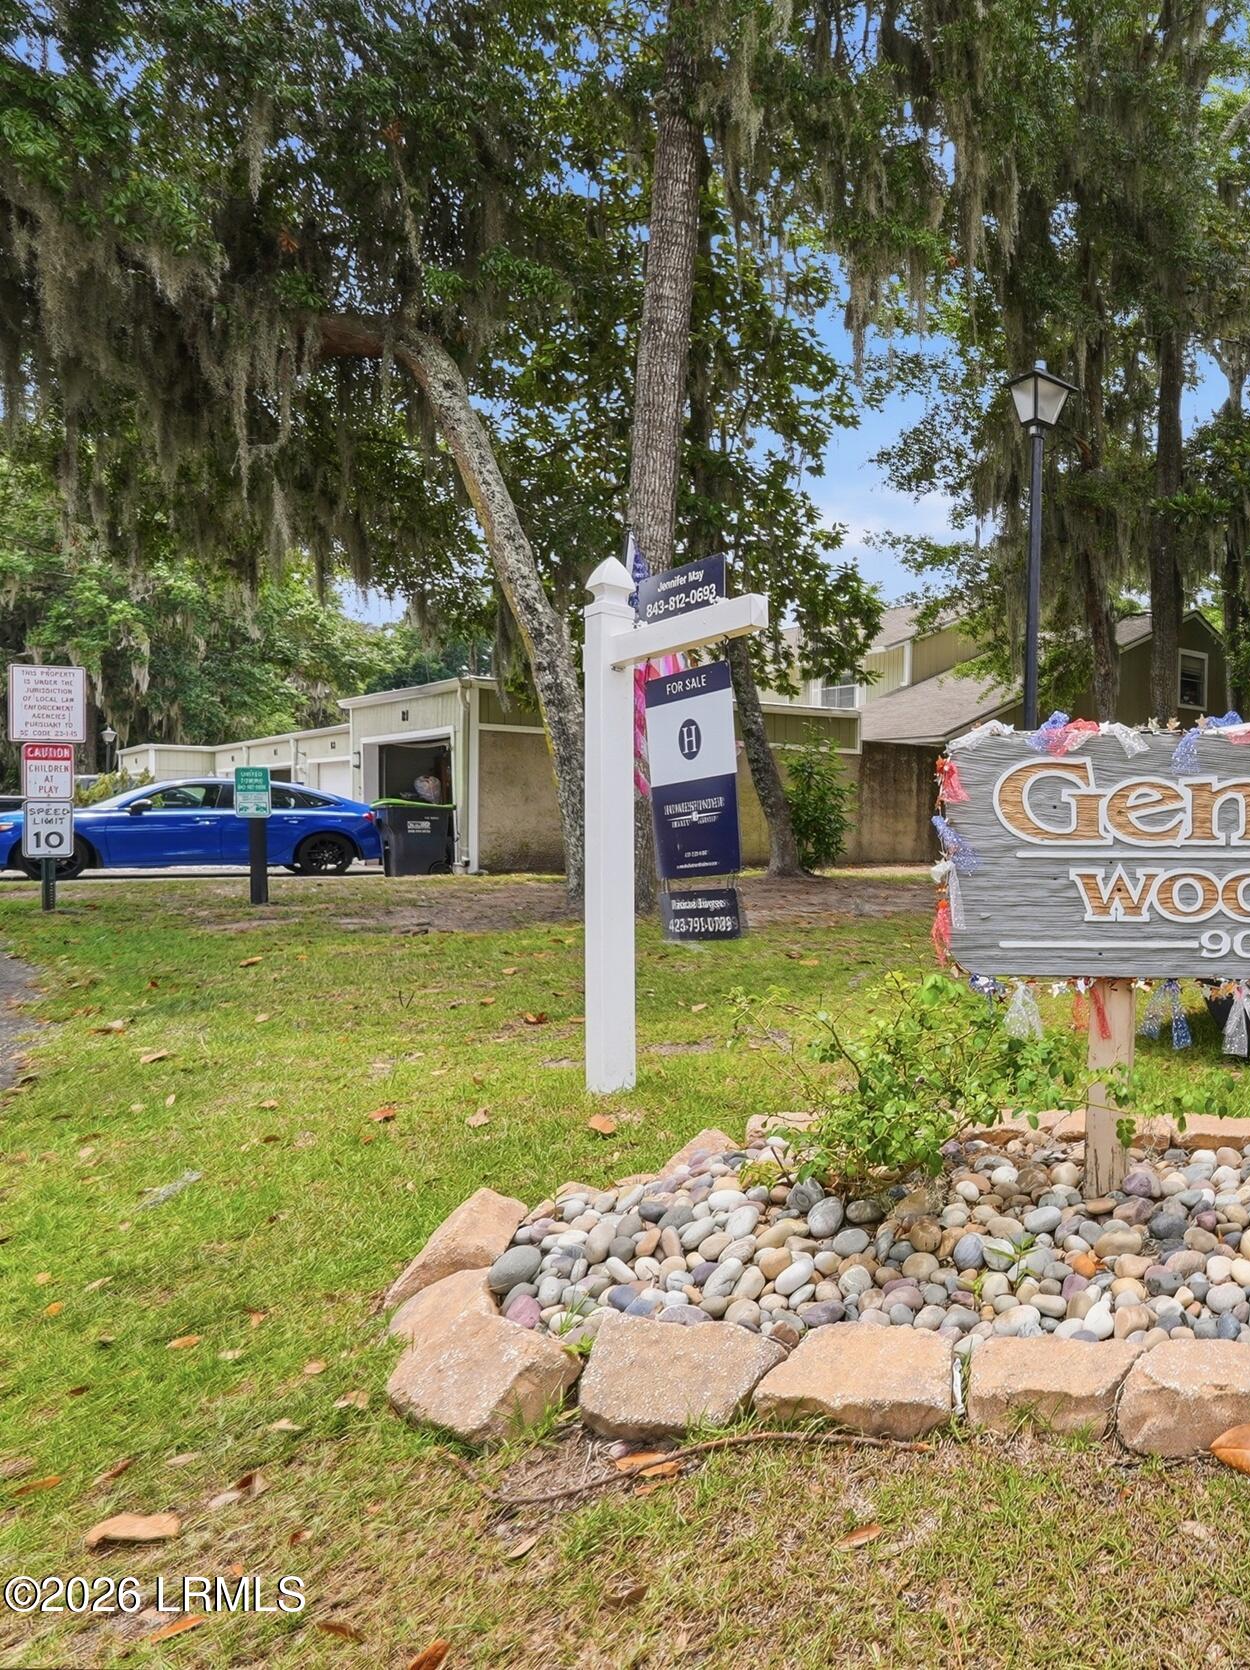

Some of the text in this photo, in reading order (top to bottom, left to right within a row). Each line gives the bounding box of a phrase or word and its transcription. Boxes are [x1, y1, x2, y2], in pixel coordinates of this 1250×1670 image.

[657, 569, 705, 593] Jennifer May
[646, 583, 717, 618] 843-812-0693
[40, 670, 75, 678] PROPERTY
[666, 674, 707, 695] FOR SALE
[25, 687, 73, 695] JURISDICTION
[32, 712, 66, 720] AGENCIES
[682, 725, 697, 754] H
[27, 747, 70, 758] CAUTION
[28, 764, 70, 773] CHILDREN
[44, 775, 54, 783] AT
[38, 785, 59, 794] PLAY
[29, 807, 70, 816] SPEED
[32, 817, 65, 825] LIMIT
[33, 831, 64, 849] 10
